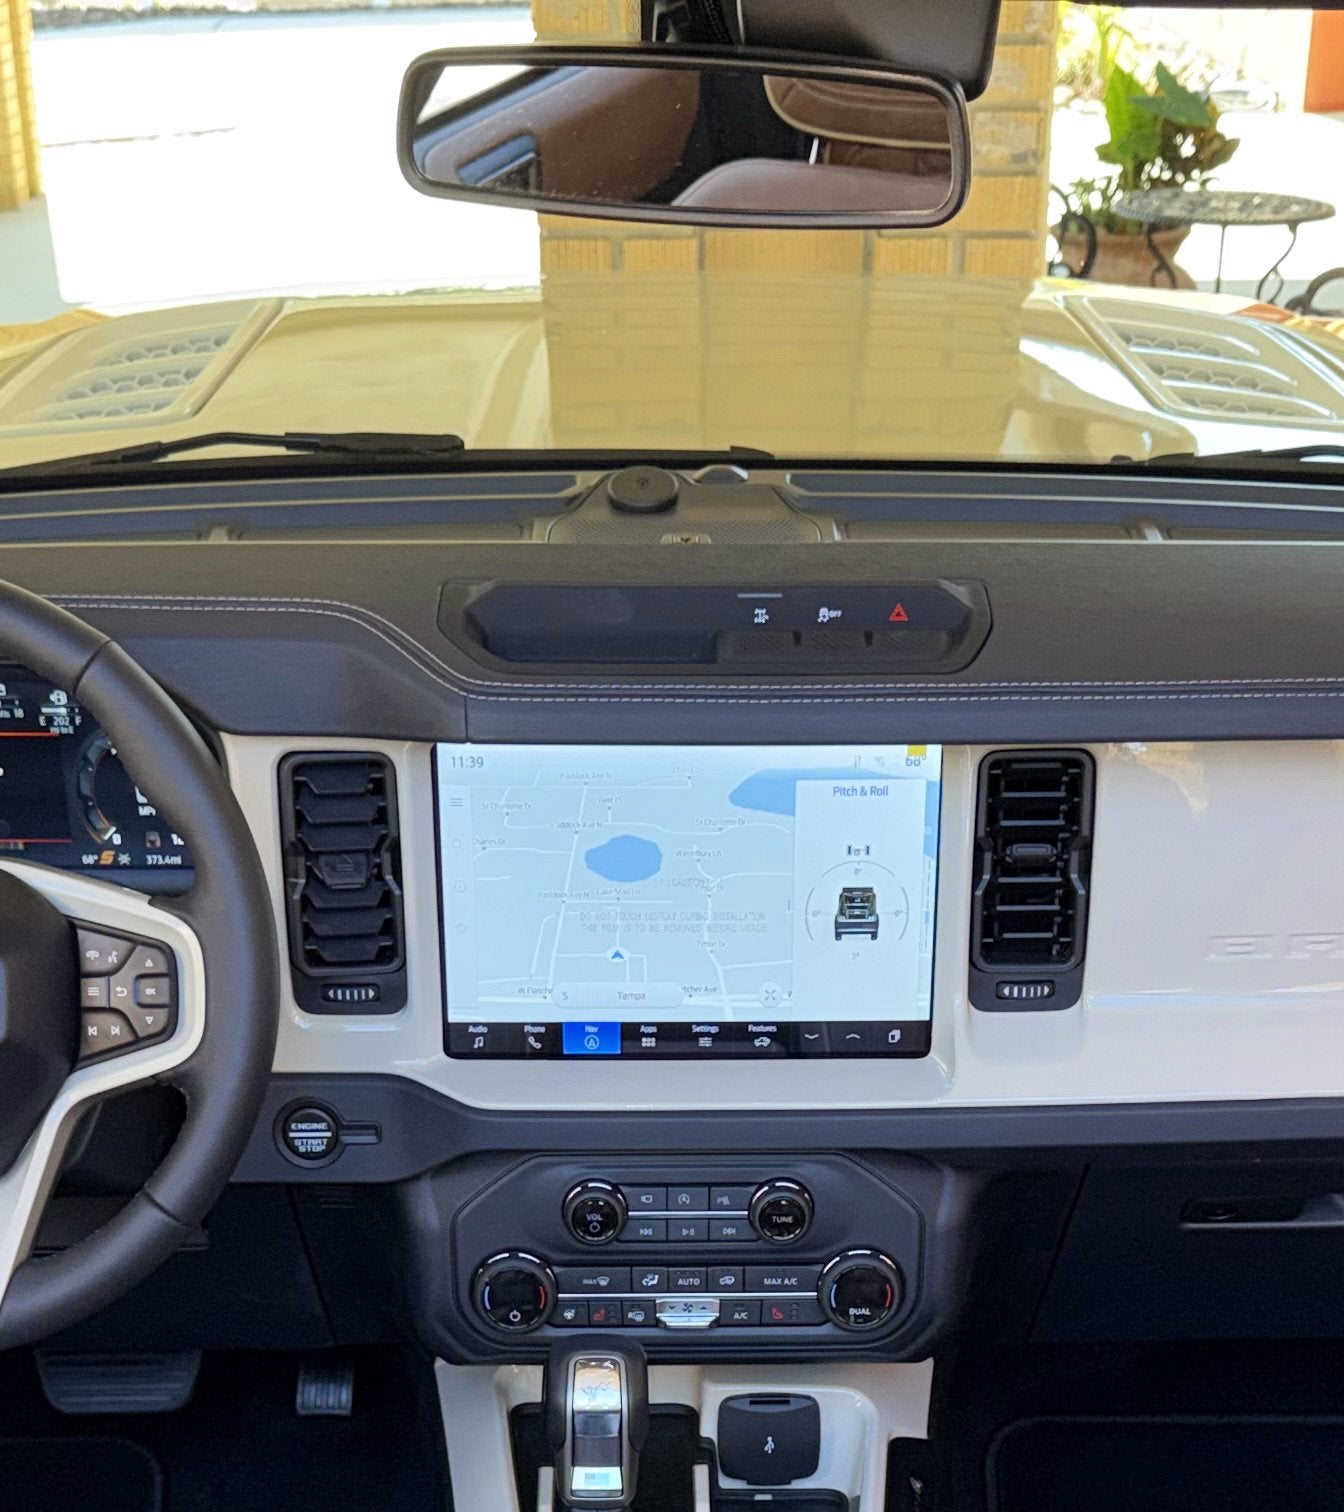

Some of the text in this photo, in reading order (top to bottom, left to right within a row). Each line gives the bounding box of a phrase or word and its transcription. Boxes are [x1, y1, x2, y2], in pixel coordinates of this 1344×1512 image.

[450, 755, 485, 769] 11:39
[833, 785, 889, 797] Pitch & Roll
[468, 1024, 488, 1034] Audio
[691, 1024, 719, 1034] Settings
[291, 1122, 328, 1130] ENGINE
[586, 1213, 603, 1222] VOL
[677, 1277, 701, 1287] AUTO
[763, 1276, 798, 1286] MAX A/C
[733, 1310, 748, 1320] A/C
[849, 1307, 871, 1316] DUAL
